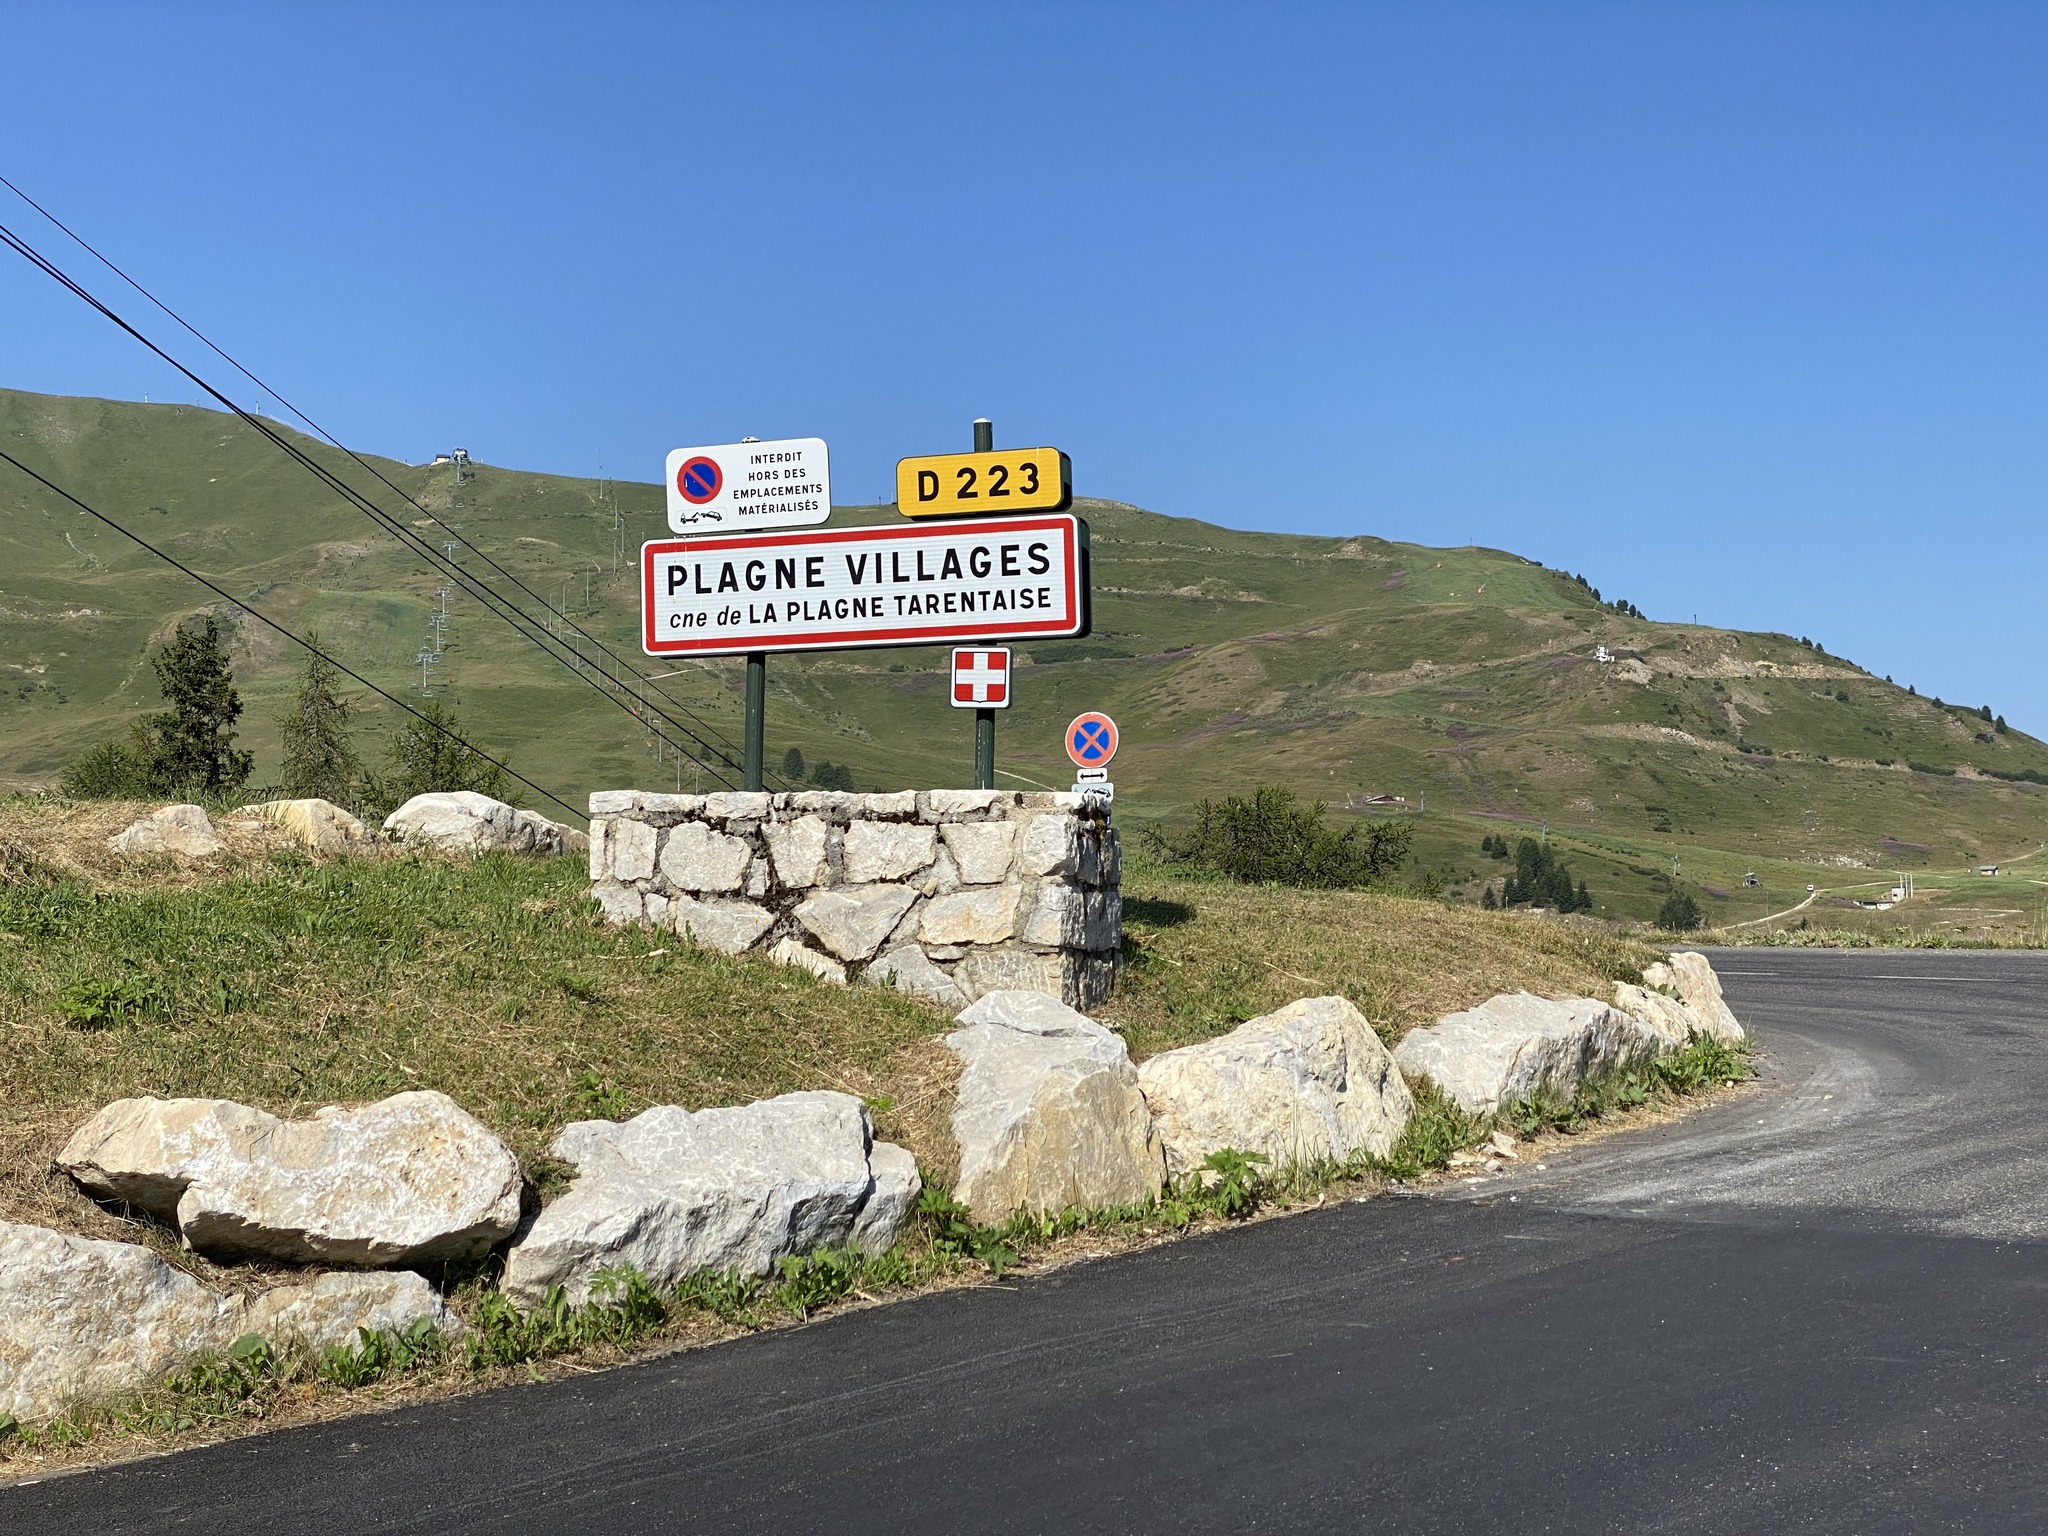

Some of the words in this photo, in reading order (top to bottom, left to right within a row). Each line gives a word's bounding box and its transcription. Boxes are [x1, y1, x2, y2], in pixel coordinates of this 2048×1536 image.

[750, 451, 802, 465] INTERDIT
[748, 470, 779, 482] HORS
[784, 468, 806, 479] DES
[917, 470, 940, 502] D
[956, 462, 1040, 500] 223
[733, 483, 823, 500] EMPLACEMENTS
[738, 499, 819, 516] MATÉRIALISÉS
[667, 556, 825, 596] PLAGNE
[845, 542, 1050, 585] VILLAGES
[670, 612, 707, 629] cne
[717, 605, 741, 626] de
[749, 602, 777, 624] LA
[787, 596, 884, 622] PLAGNE
[893, 587, 1051, 616] TARENTAISE
